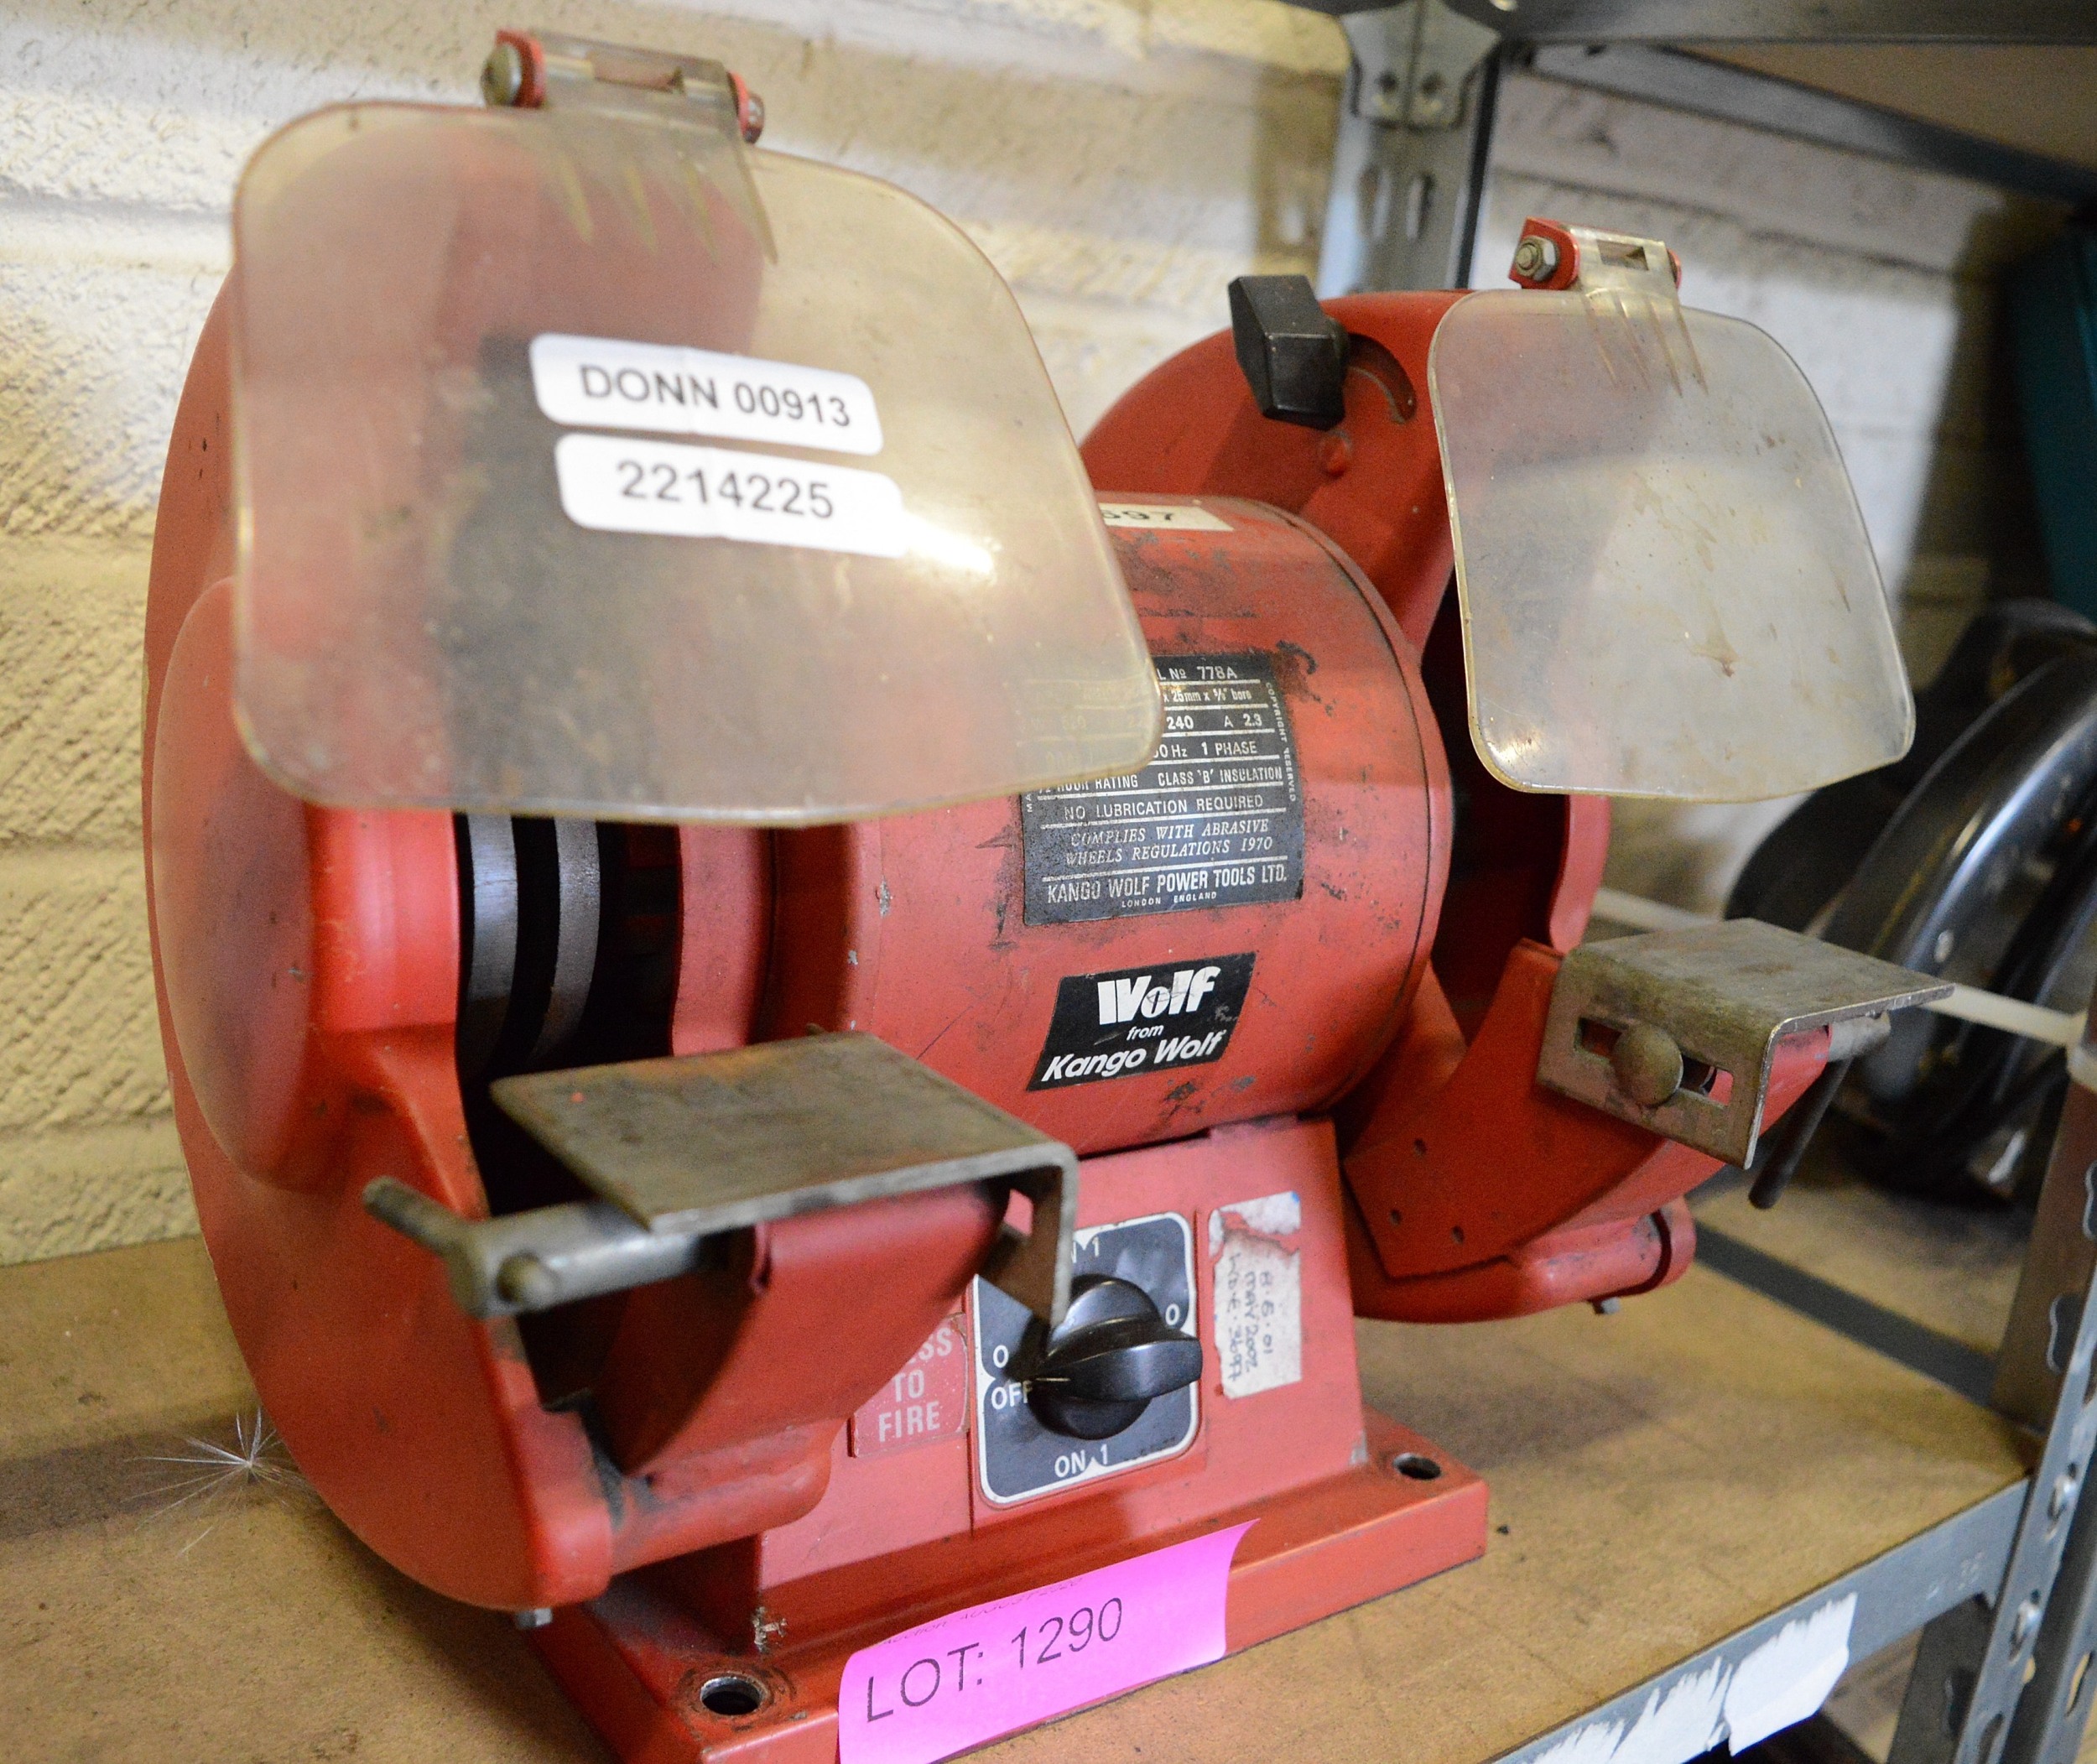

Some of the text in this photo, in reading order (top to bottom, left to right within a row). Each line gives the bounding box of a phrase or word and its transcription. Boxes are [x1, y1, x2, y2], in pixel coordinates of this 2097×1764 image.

[579, 363, 851, 428] DONN 00913
[616, 459, 834, 519] 2214225
[1196, 666, 1238, 680] 778A
[1171, 689, 1202, 703] 25mm
[1231, 688, 1252, 701] bore
[1166, 713, 1262, 730] 240 A 2.3
[1266, 682, 1288, 742] COPYRIGHT
[1201, 742, 1208, 756] 1
[1215, 741, 1258, 756] PHASE
[1095, 774, 1139, 789] RATING
[1158, 772, 1194, 787] CLASS
[1220, 766, 1283, 783] INSULATION
[1064, 794, 1263, 820] NO LUBRICATION REQUIRED
[1070, 819, 1269, 847] COMPLIES WITH ABRASIVE
[1065, 836, 1273, 866] WHEELS REGULATIONS 1970
[1048, 863, 1288, 903] KANGO WOLF POWER TOOLS LTD.
[1121, 891, 1217, 908] LONDON ENGLAND
[1097, 966, 1221, 1025] Wolf
[1126, 1025, 1164, 1042] from
[1041, 1029, 1228, 1082] Kango Wolf
[908, 1327, 953, 1364] SS
[893, 1369, 924, 1403] TO
[991, 1380, 1033, 1410] OFF
[878, 1401, 940, 1443] FIRE
[1054, 1444, 1109, 1478] ON 1
[866, 1597, 1123, 1723] LOT: 1290
